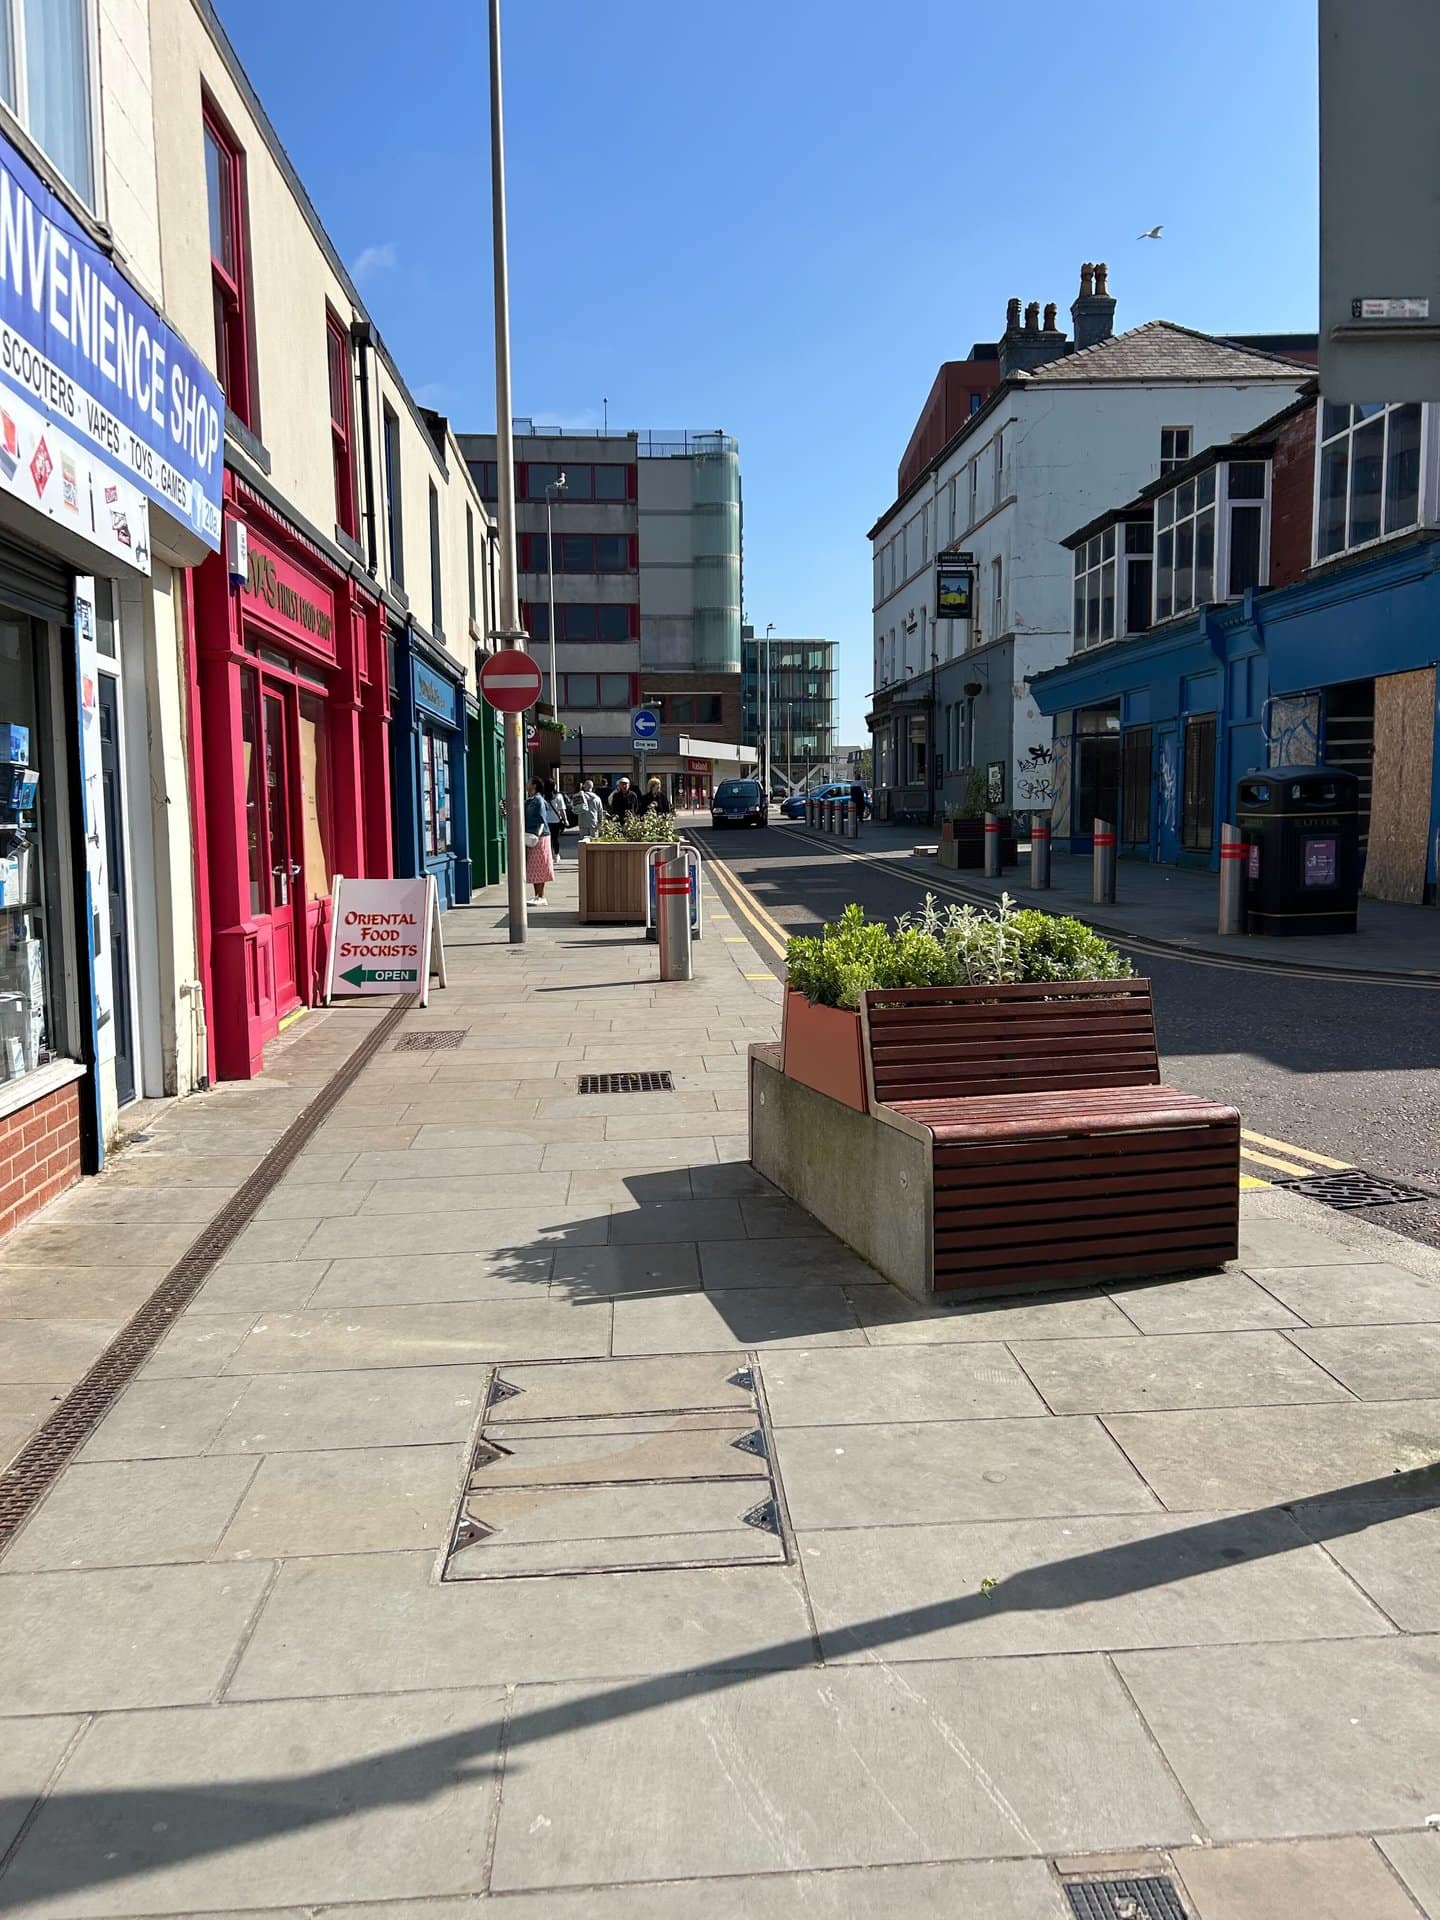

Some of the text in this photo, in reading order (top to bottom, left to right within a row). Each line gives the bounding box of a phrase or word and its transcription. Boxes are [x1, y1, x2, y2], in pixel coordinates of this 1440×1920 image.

[3, 330, 75, 418] SCOOTERS
[86, 398, 120, 454] VAPES
[129, 436, 153, 480] TOYS
[160, 463, 187, 509] GAMES
[171, 364, 219, 475] SHOP
[278, 580, 300, 624] FINEST
[299, 595, 316, 633] FOOD
[316, 608, 331, 642] SHOP
[345, 911, 417, 925] ORIENTAL
[360, 927, 400, 941] FOOD
[340, 942, 418, 957] STOCKISTS
[375, 971, 409, 981] OPEN
